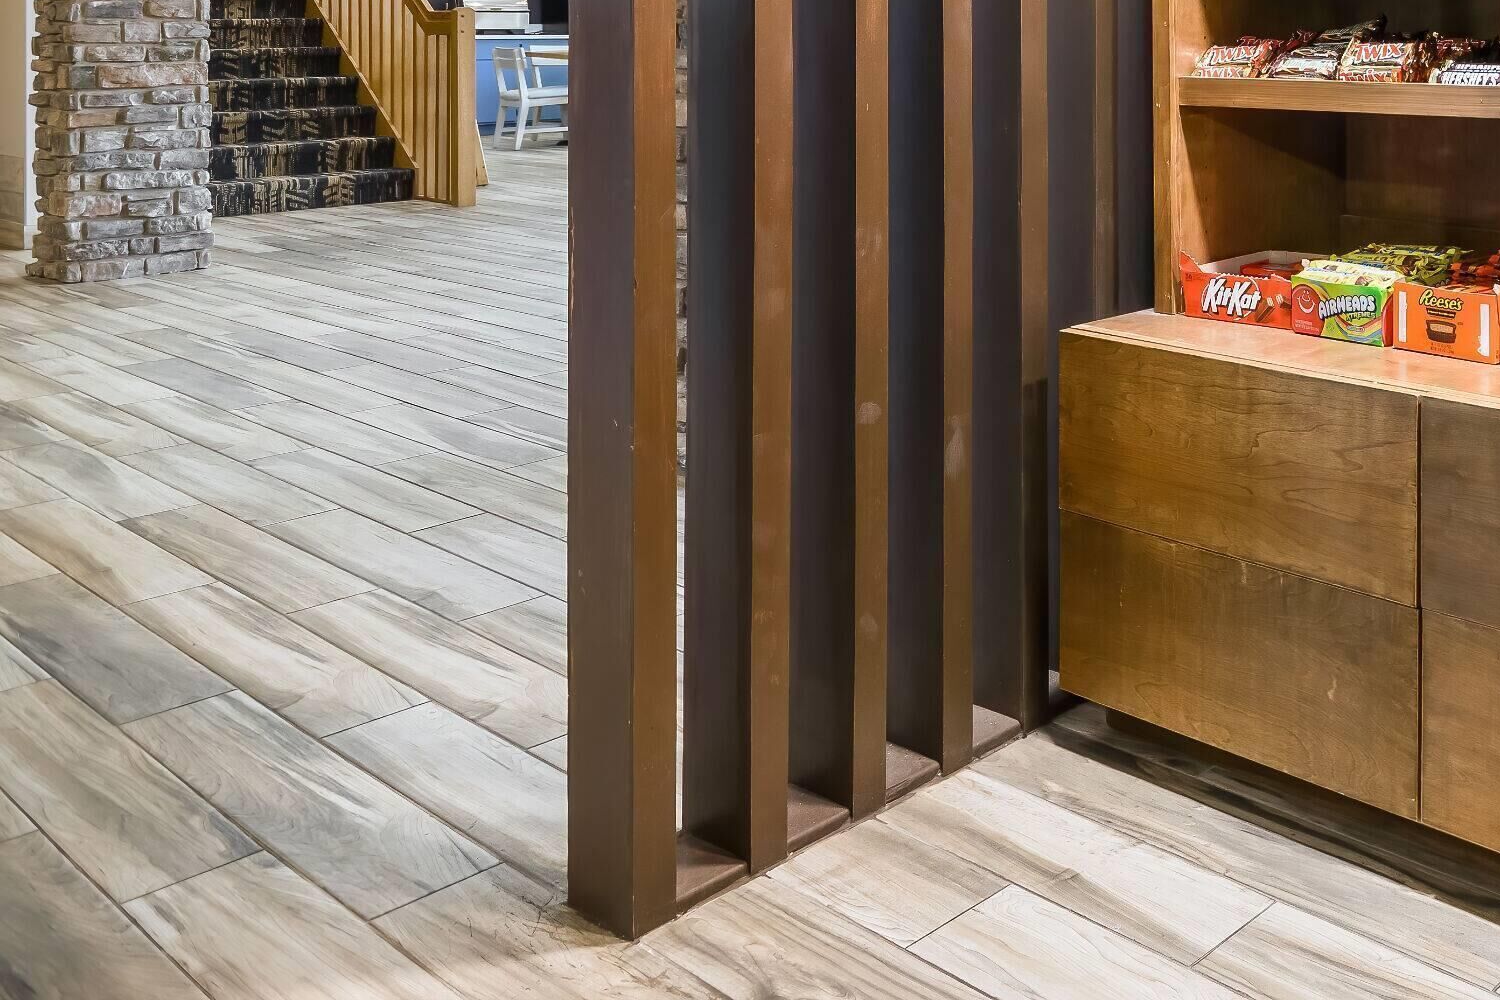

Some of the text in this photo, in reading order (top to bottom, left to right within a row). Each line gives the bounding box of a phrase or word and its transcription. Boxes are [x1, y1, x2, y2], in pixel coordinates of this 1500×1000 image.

[1212, 46, 1255, 63] TWIX
[1354, 43, 1404, 62] TWIX
[1318, 296, 1376, 319] AIRHEADS
[1419, 289, 1464, 311] Reese's
